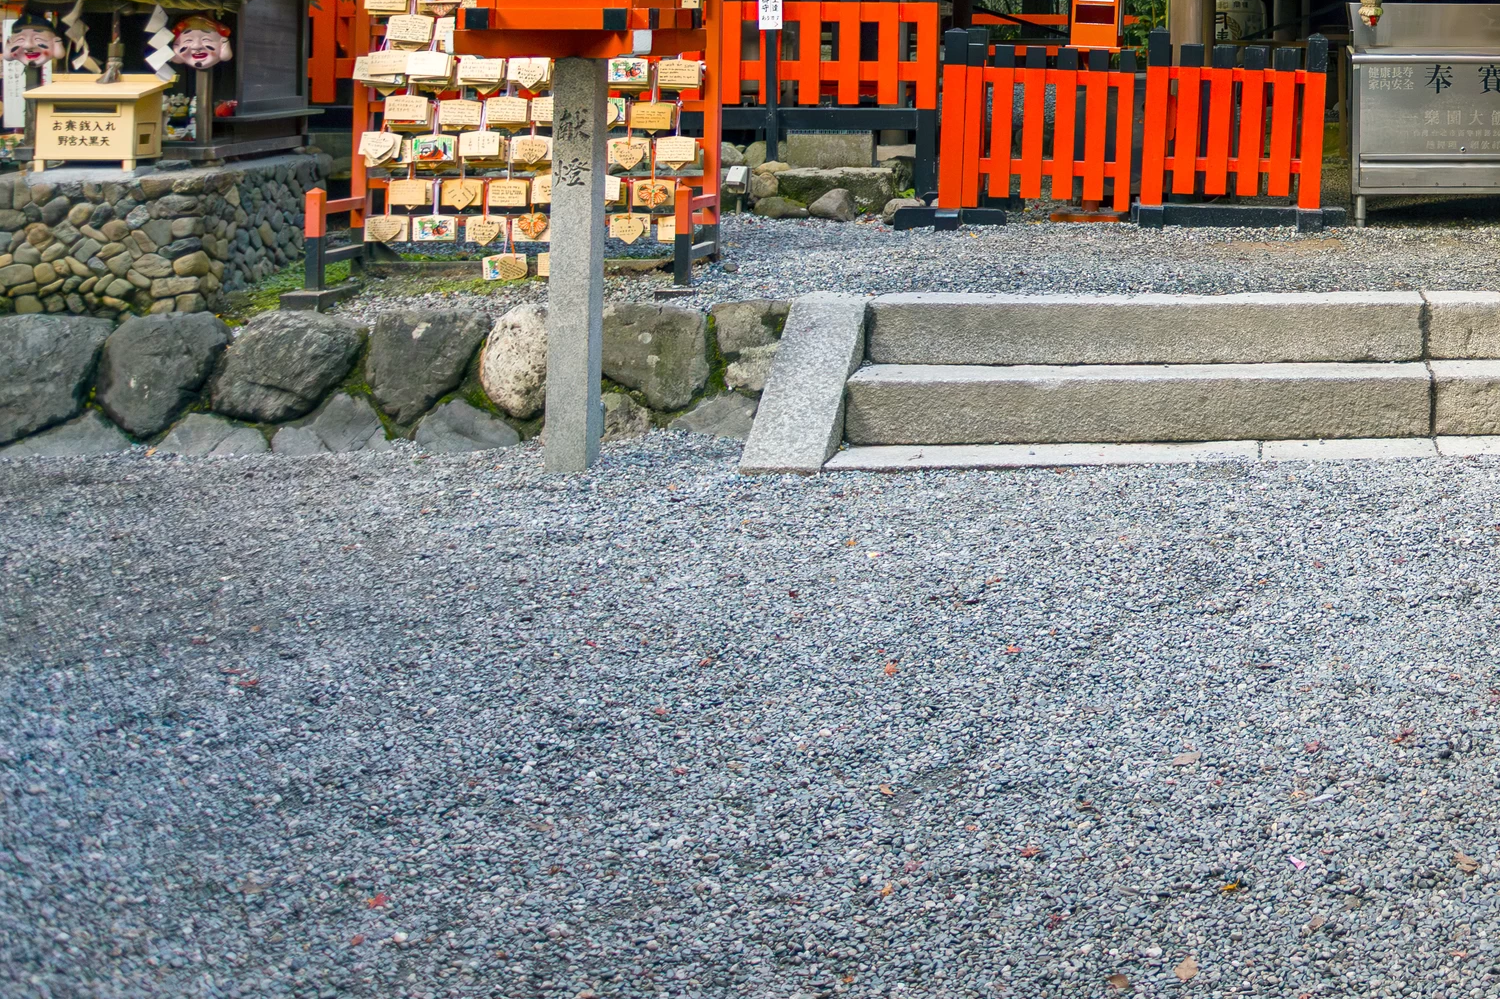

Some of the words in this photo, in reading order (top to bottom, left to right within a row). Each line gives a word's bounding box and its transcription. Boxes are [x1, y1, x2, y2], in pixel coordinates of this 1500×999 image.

[1368, 66, 1414, 78] 健康長寿
[52, 120, 116, 131] お賽銭入れ
[555, 107, 592, 187] 献燈
